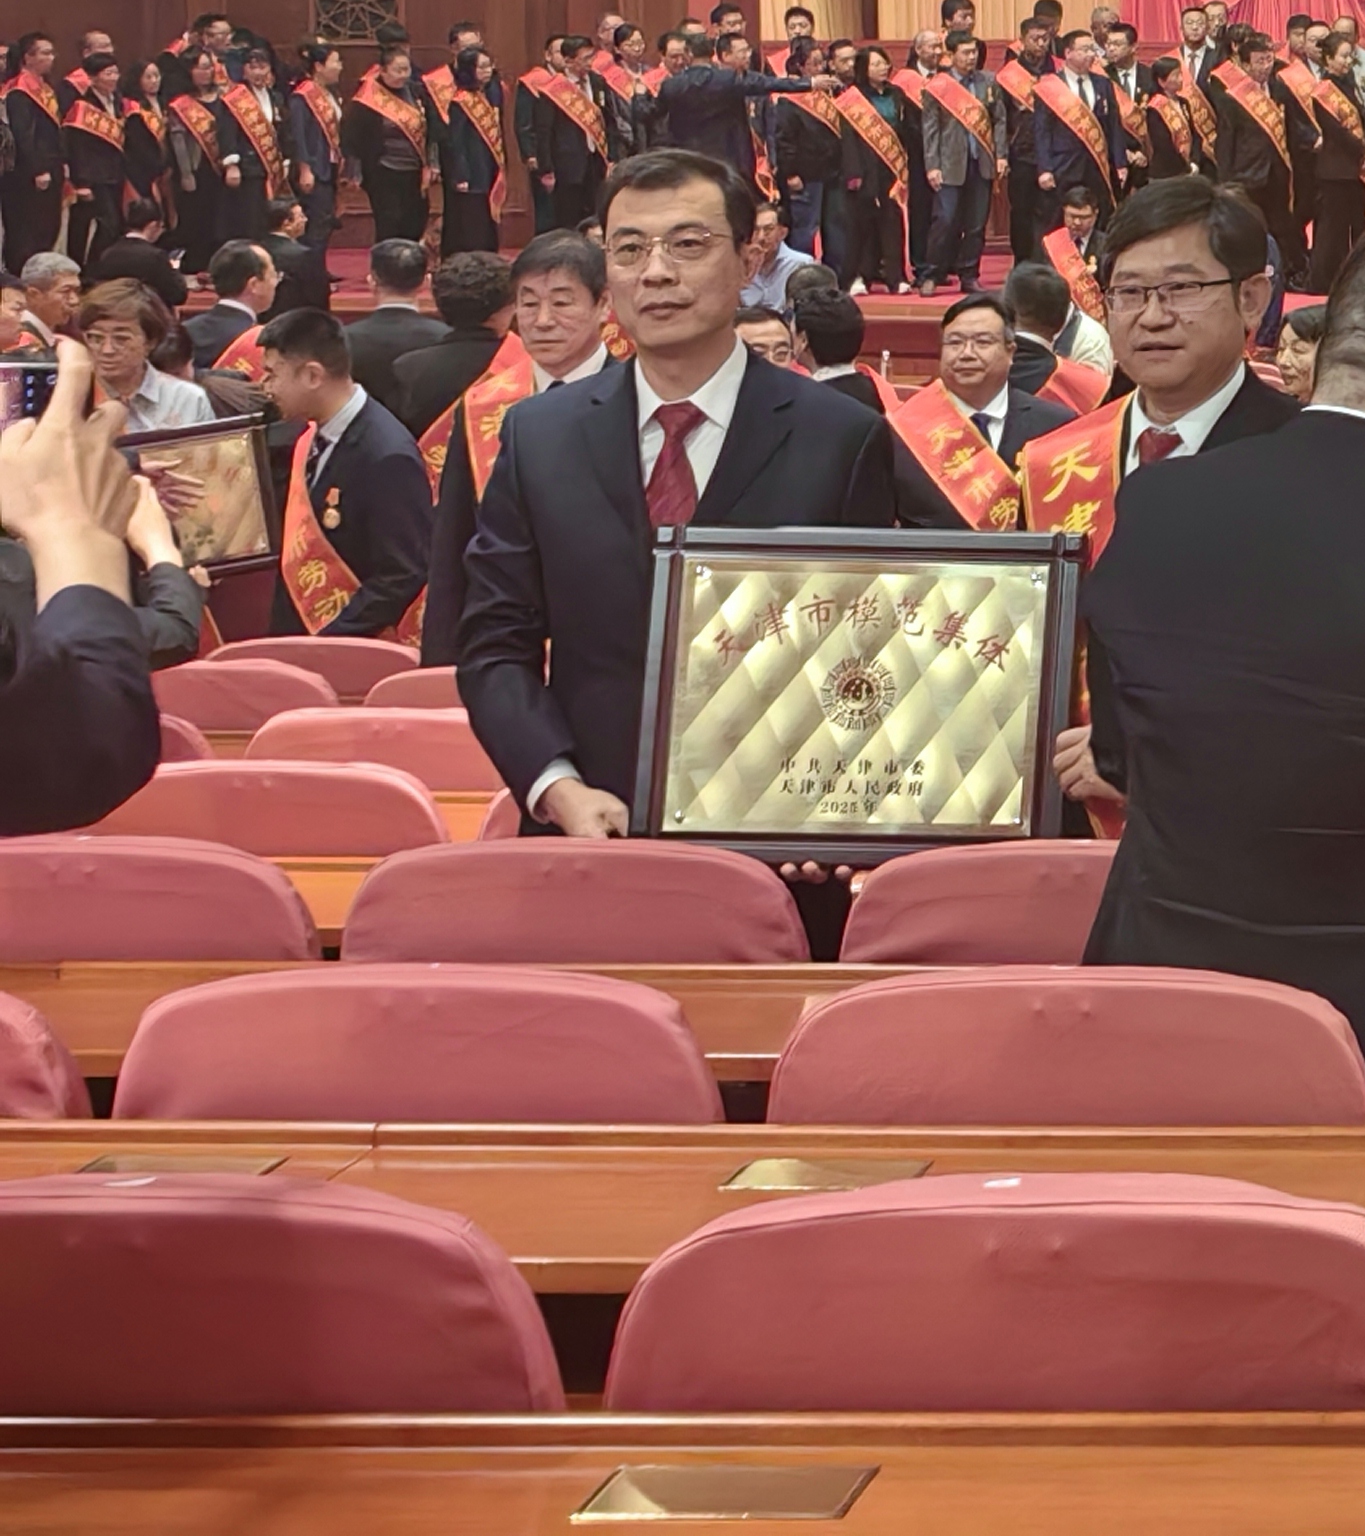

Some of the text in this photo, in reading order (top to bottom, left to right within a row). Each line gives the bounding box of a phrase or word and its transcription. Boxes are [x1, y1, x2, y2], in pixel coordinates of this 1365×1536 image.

[712, 592, 1014, 673] 天津市模范集体
[779, 777, 926, 797] 天津市人民政府
